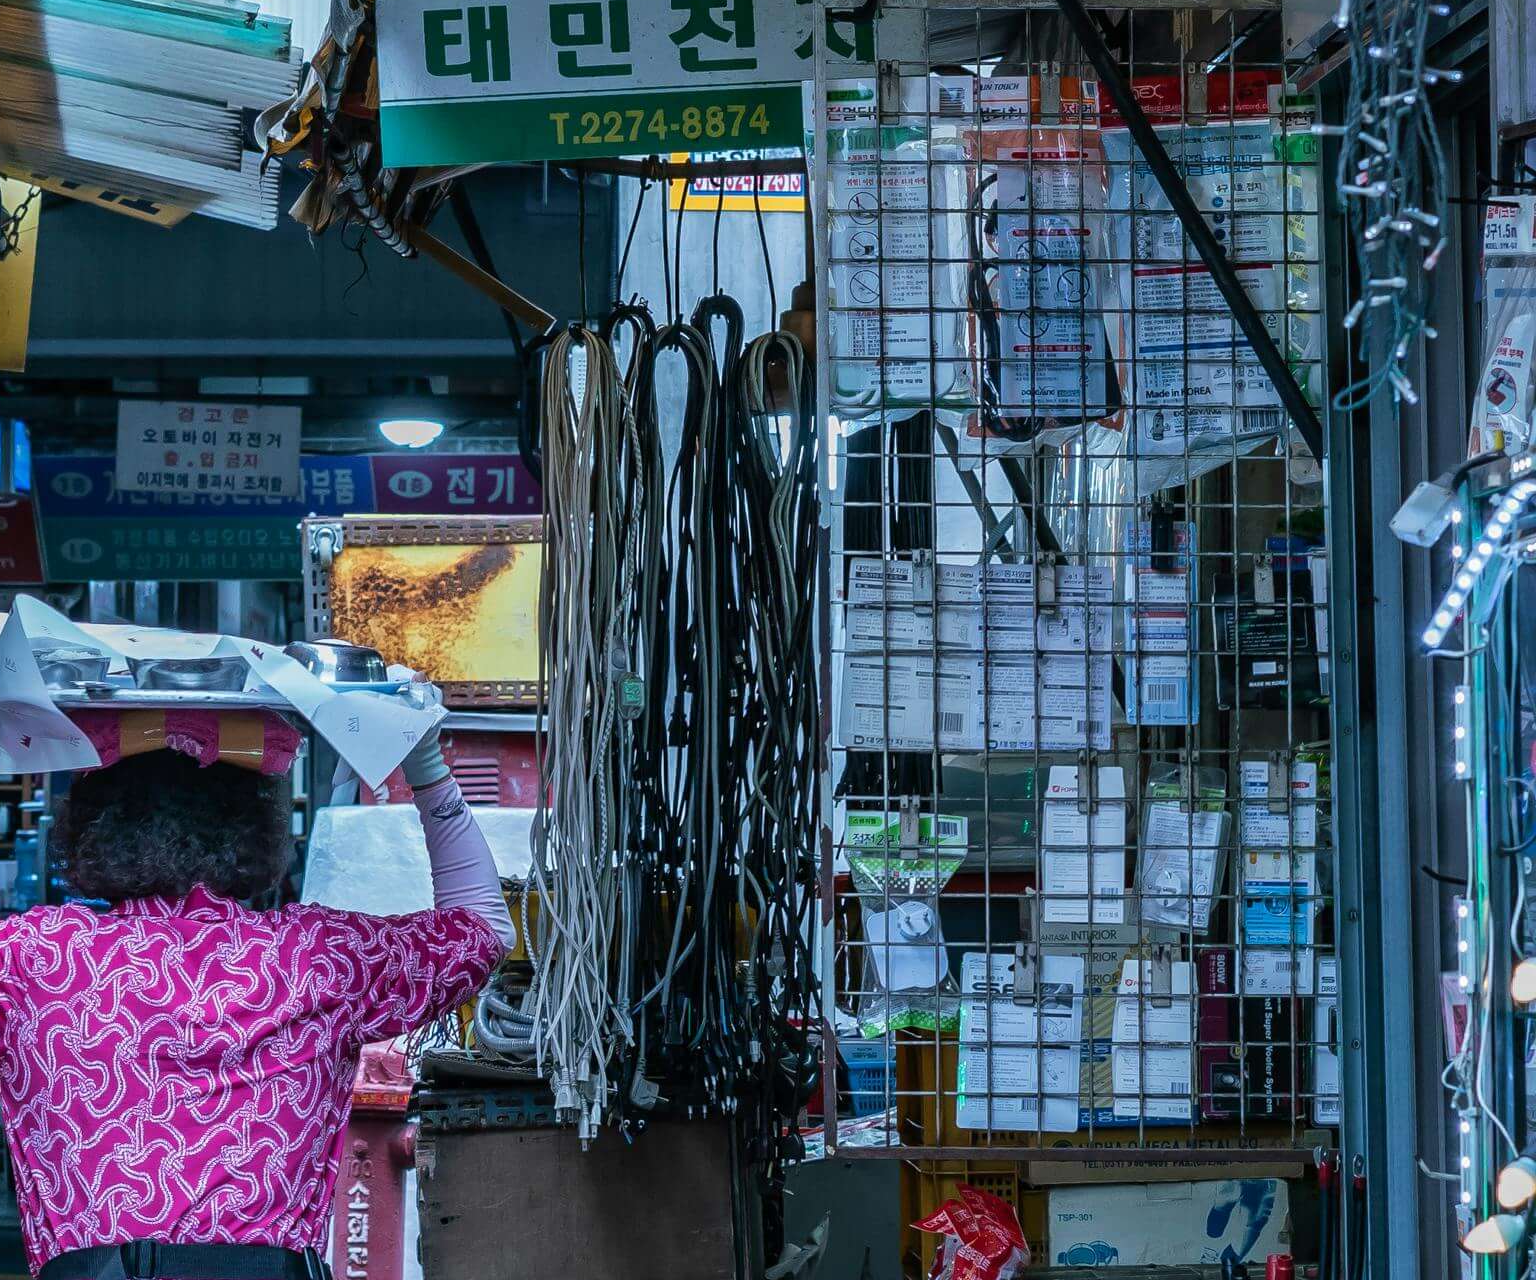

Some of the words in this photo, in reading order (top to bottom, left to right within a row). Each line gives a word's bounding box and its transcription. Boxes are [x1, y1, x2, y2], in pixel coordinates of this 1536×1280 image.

[549, 104, 770, 146] T.2274-8874
[141, 428, 218, 446] 오토바이
[227, 430, 282, 448] 자전거
[1040, 932, 1069, 942] ANTASIA
[1057, 1214, 1094, 1223] TSP-301
[345, 1180, 370, 1278] 소화전
